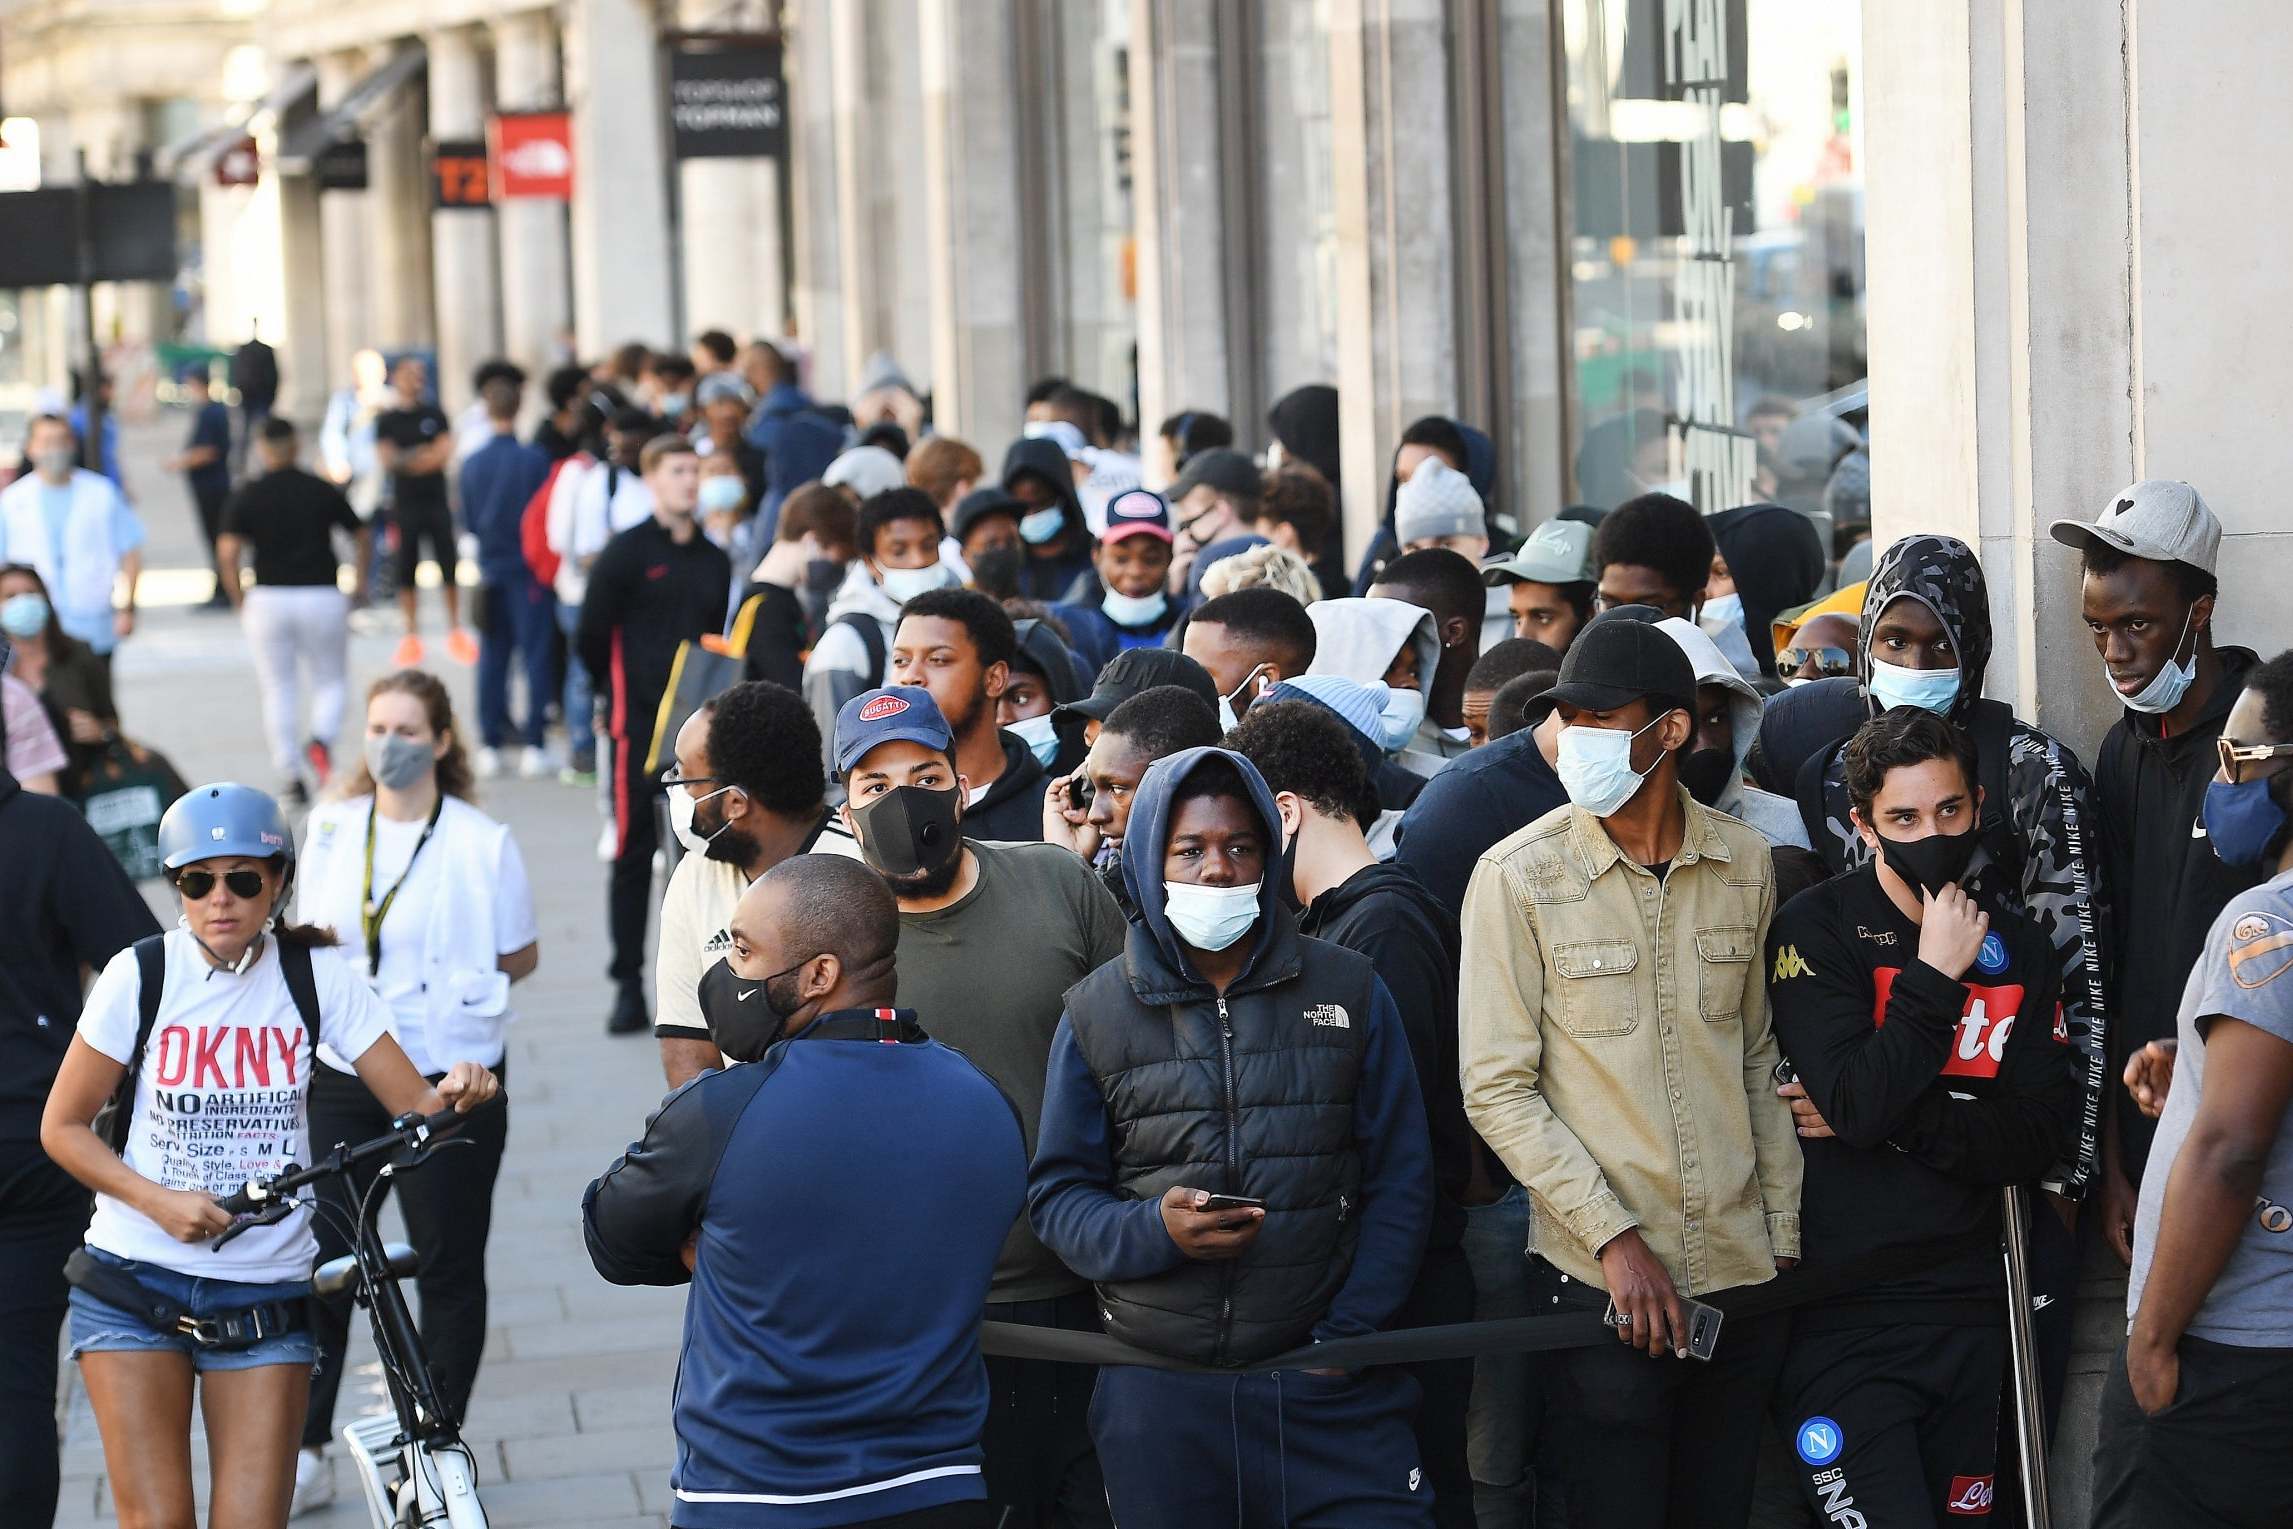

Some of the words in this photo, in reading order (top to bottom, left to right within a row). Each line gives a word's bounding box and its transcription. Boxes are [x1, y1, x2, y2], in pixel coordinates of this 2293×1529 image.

[675, 104, 779, 129] TOPMAN
[863, 701, 905, 718] BUGATTI
[2041, 753, 2067, 778] NIKE
[2058, 785, 2076, 817] NIKE
[260, 831, 284, 846] bern
[2065, 823, 2083, 855] NIKE
[2071, 861, 2088, 894] NIKE
[2076, 901, 2094, 933] NIKE
[2082, 939, 2100, 972] NIKE
[2088, 978, 2105, 1011] NIKE
[1303, 1010, 1336, 1019] NORTH
[1316, 1004, 1335, 1013] THE
[1313, 1018, 1336, 1027] FACE
[2090, 1016, 2106, 1050] NIKE
[157, 1024, 303, 1089] DKNY
[2087, 1054, 2104, 1088] NIKE
[156, 1089, 201, 1115] NO
[204, 1104, 296, 1116] INGREDIENTS
[2083, 1092, 2099, 1127] NIKE
[168, 1129, 234, 1141] TRITION
[186, 1142, 225, 1158] Size
[258, 1143, 273, 1156] M
[282, 1139, 297, 1156] L
[203, 1172, 212, 1182] of
[239, 1160, 269, 1170] Love
[212, 1183, 223, 1193] or
[2033, 1294, 2048, 1307] IKE
[1807, 1427, 1829, 1454] N
[1812, 1467, 1844, 1486] SSC
